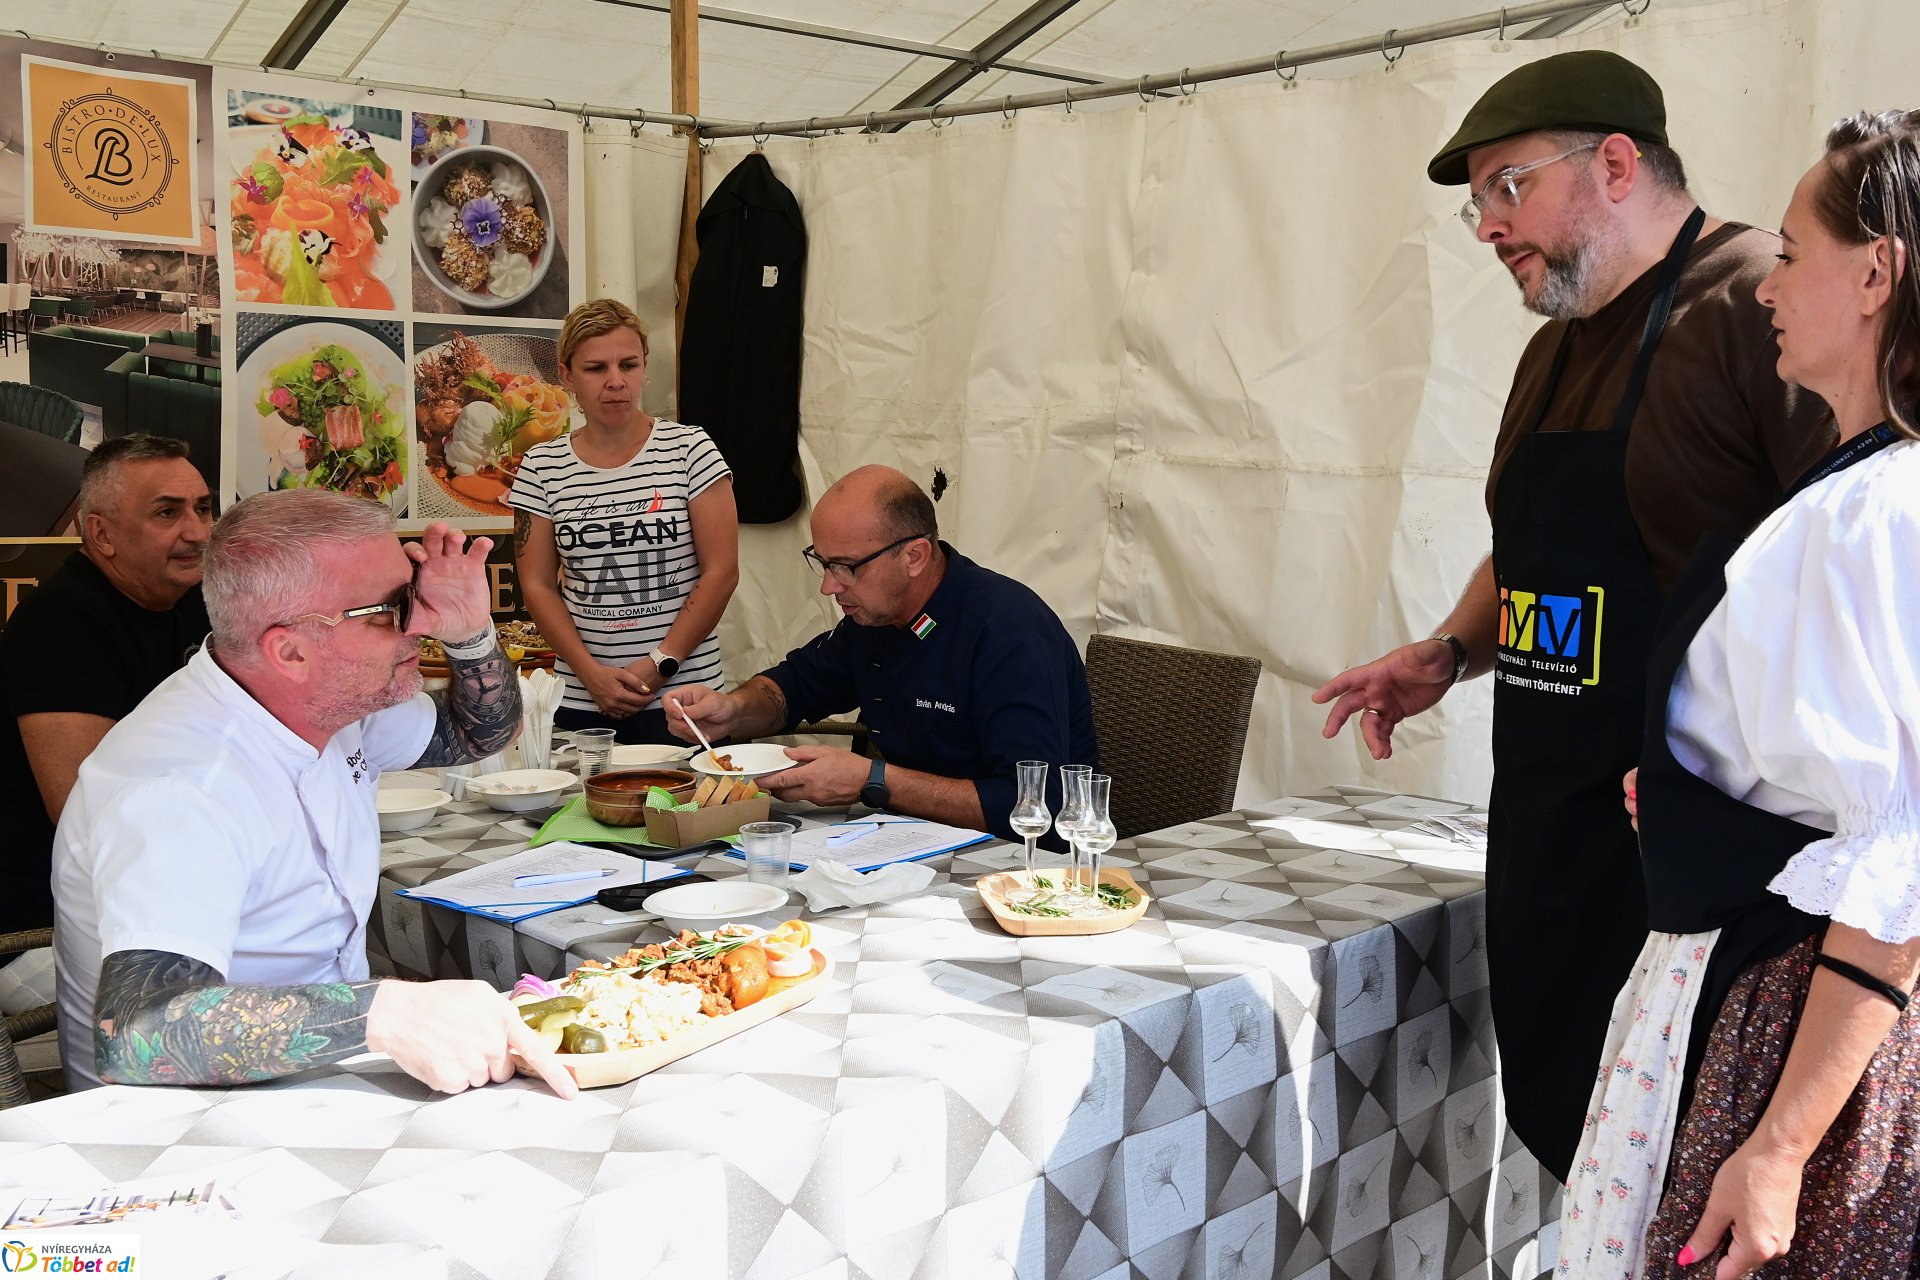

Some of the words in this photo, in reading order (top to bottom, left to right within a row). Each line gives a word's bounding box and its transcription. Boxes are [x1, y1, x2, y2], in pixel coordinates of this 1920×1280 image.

[62, 104, 105, 154] BISTRO
[115, 107, 138, 126] DE
[141, 128, 162, 163] LUX
[86, 185, 141, 203] RESTAURANT
[564, 494, 600, 525] Life
[605, 499, 620, 514] is
[626, 500, 649, 512] an
[558, 516, 678, 551] OCEAN
[566, 549, 680, 605] SAIL
[582, 606, 616, 617] NAUTICAL
[618, 604, 663, 617] COMPANY
[1531, 660, 1577, 674] TELEVÍZIÓ
[1506, 673, 1532, 688] EZERNYI
[1533, 679, 1582, 696] TÖRTÉNET
